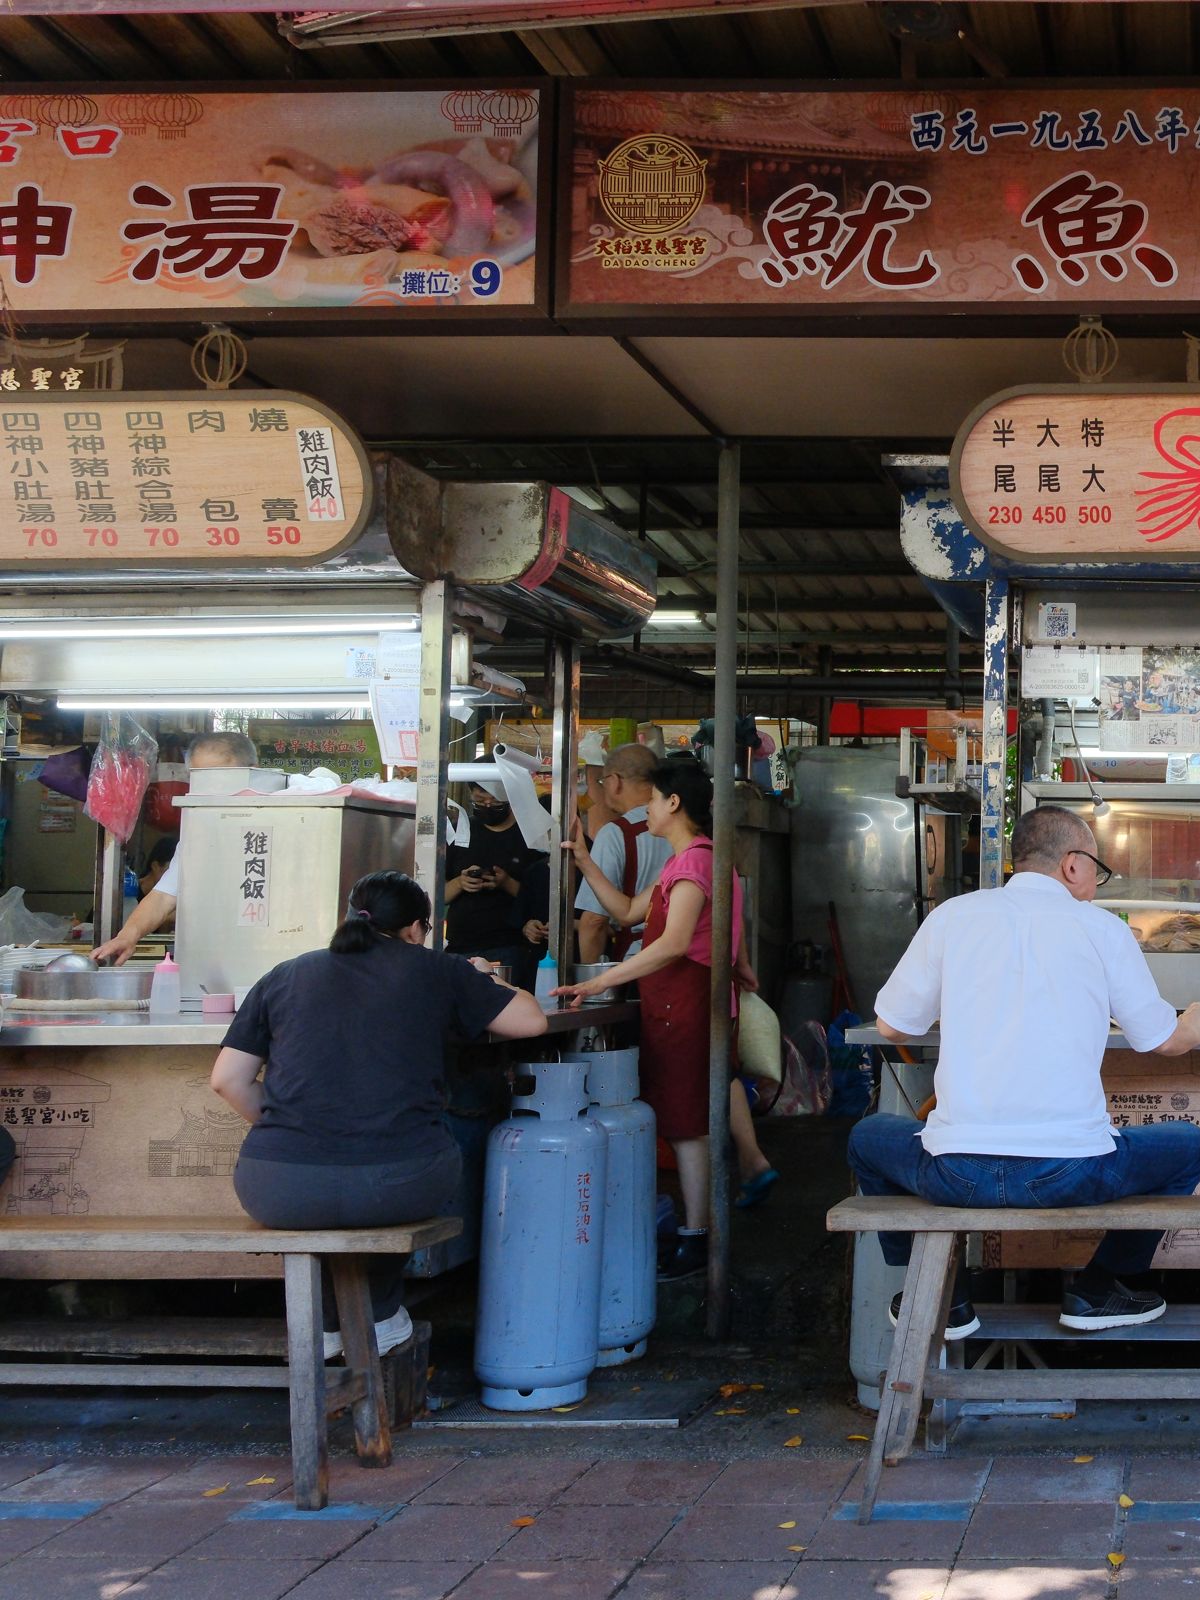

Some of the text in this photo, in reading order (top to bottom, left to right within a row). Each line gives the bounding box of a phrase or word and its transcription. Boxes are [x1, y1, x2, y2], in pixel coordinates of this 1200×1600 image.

[596, 237, 707, 256] 大稻埕慈聖宮
[604, 259, 697, 267] DA DAO CHENG
[0, 367, 84, 391] 慈聖宮
[2, 411, 58, 547] 四神小肚湯 70
[64, 411, 118, 547] 四神豬肚湯 70
[125, 410, 180, 547] 四神綜合湯 70
[298, 430, 339, 519] 雞肉飯 40
[988, 418, 1022, 524] 半尾 230
[1032, 418, 1066, 524] 大尾 450
[1078, 418, 1112, 524] 特大 500
[206, 527, 240, 546] 30
[266, 526, 301, 545] 50
[240, 831, 268, 899] 雞肉飯
[4, 1106, 90, 1125] 慈聖宮小吃
